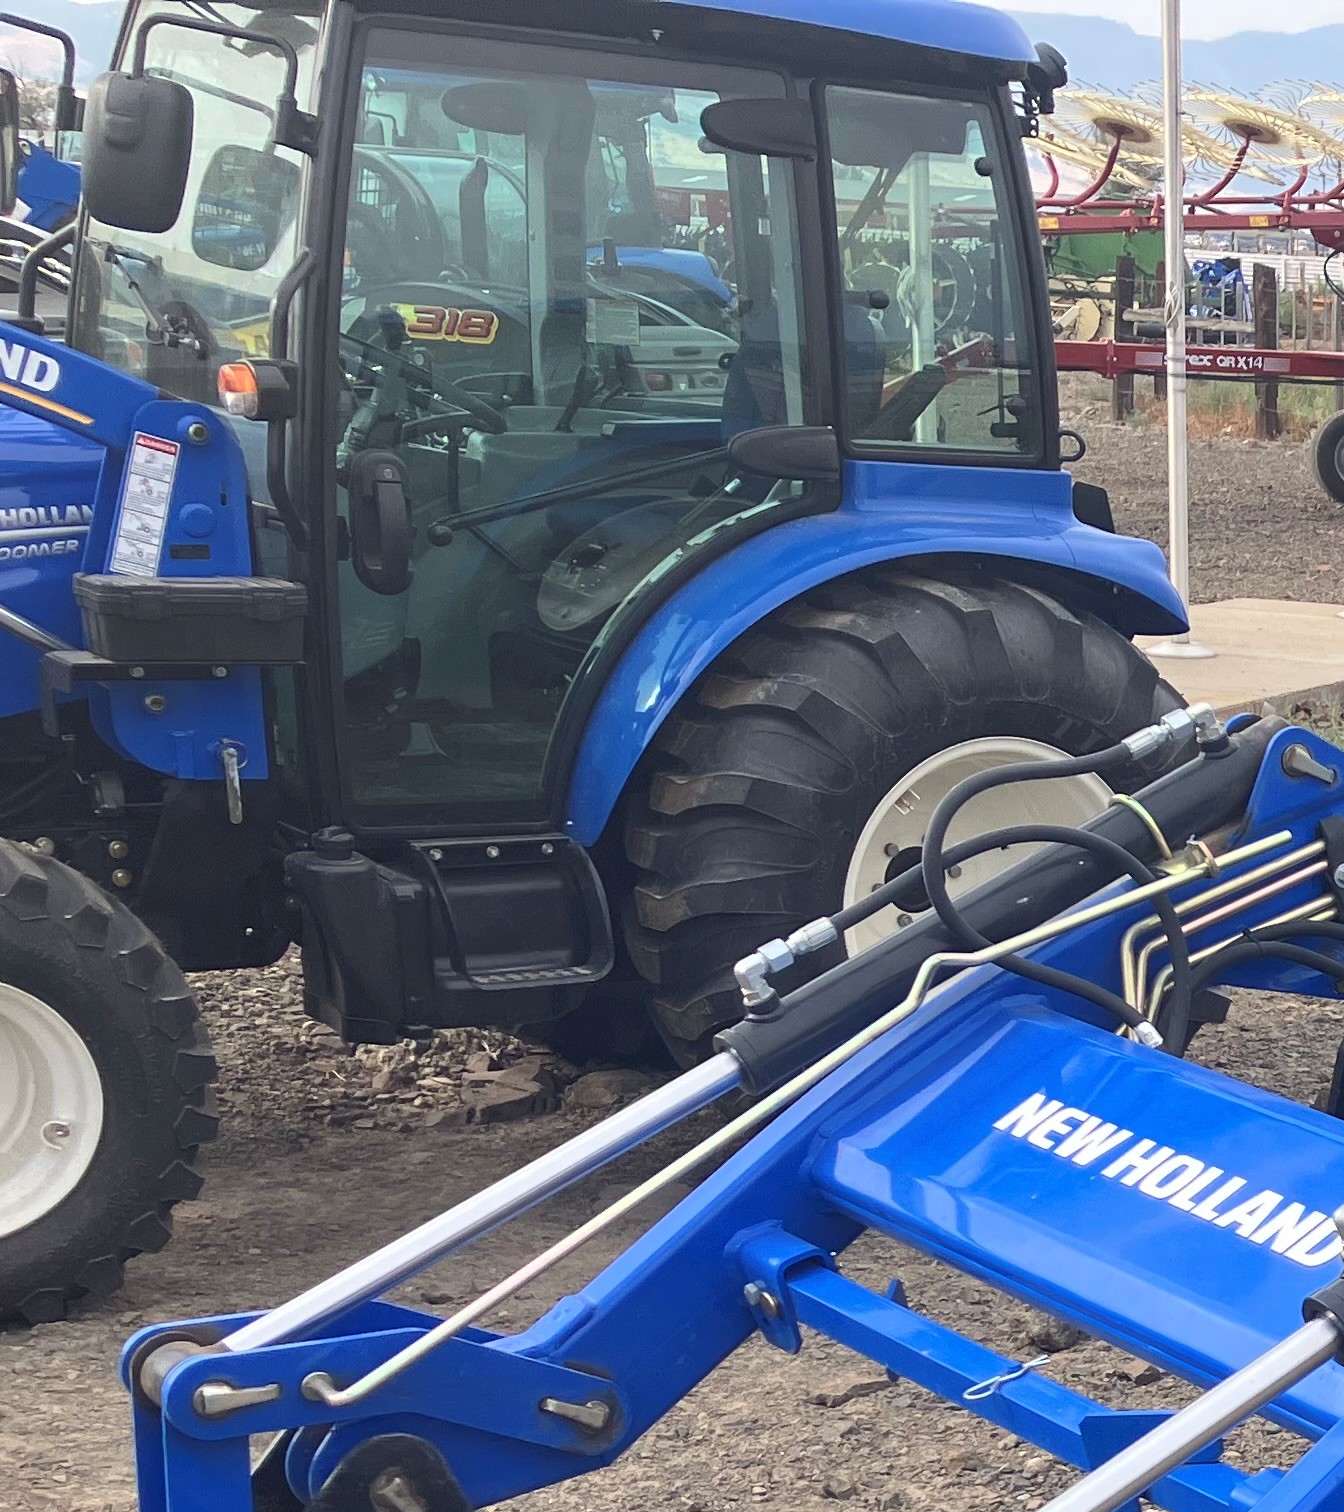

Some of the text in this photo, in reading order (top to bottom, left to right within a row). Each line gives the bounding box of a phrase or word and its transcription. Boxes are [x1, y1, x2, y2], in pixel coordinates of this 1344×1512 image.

[409, 306, 498, 342] 318
[0, 539, 79, 559] OOMER
[992, 1092, 1344, 1268] NEW HOLLAND
